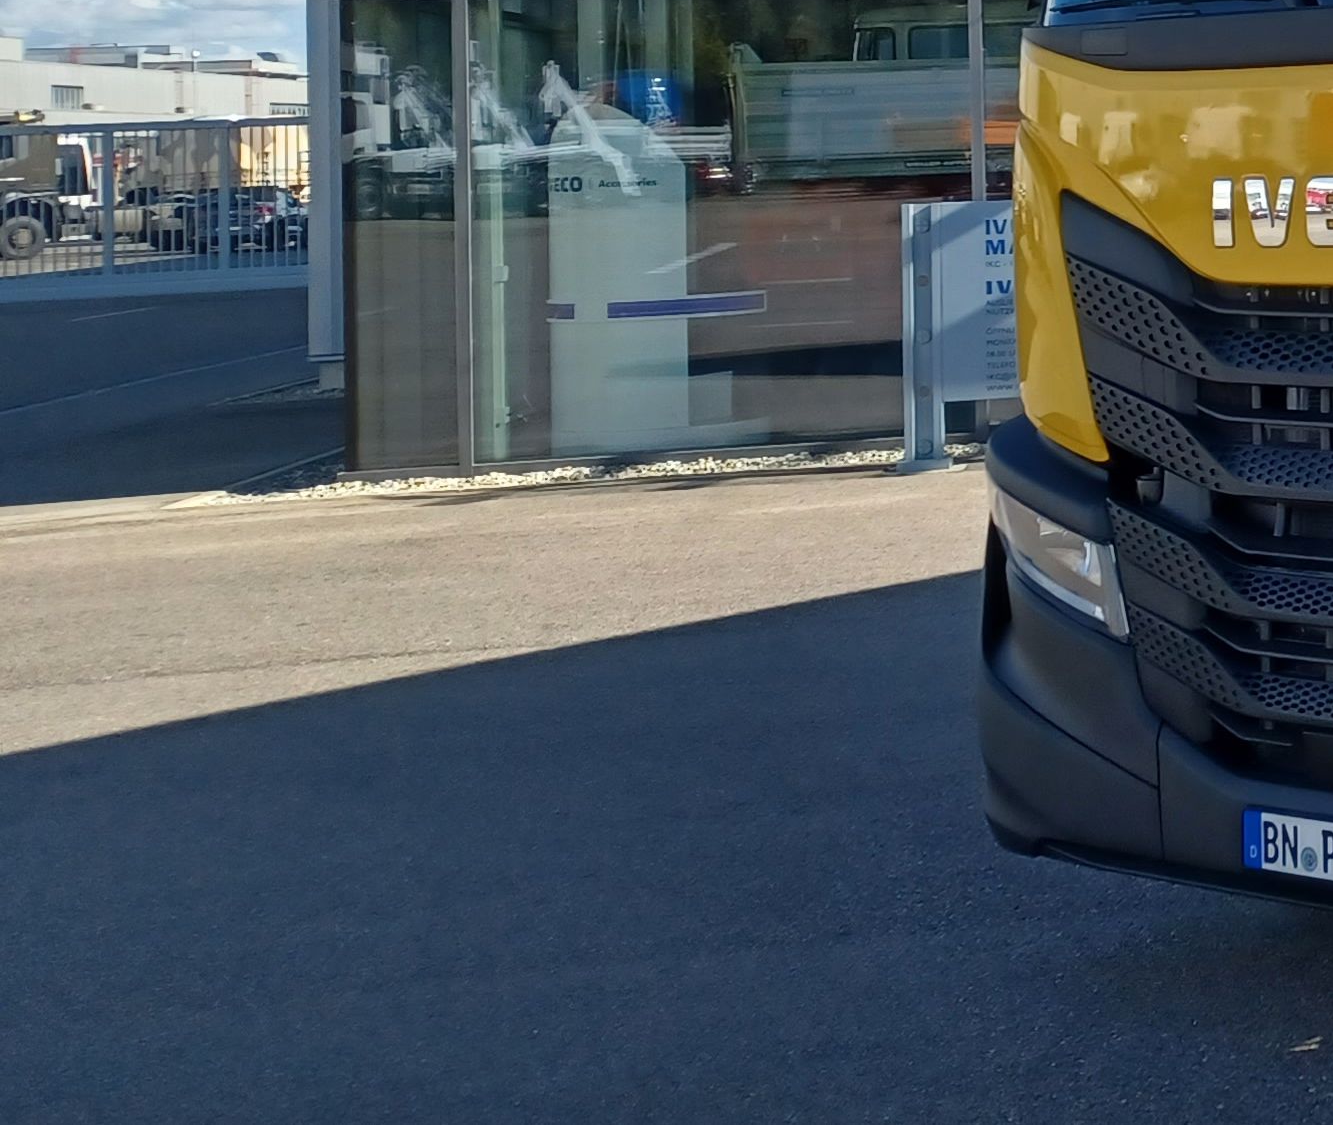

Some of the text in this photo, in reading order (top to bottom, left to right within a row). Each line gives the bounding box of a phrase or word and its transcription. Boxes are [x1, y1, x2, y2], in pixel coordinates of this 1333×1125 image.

[985, 219, 1015, 235] IV
[1249, 844, 1257, 859] D
[1263, 820, 1298, 869] BN
